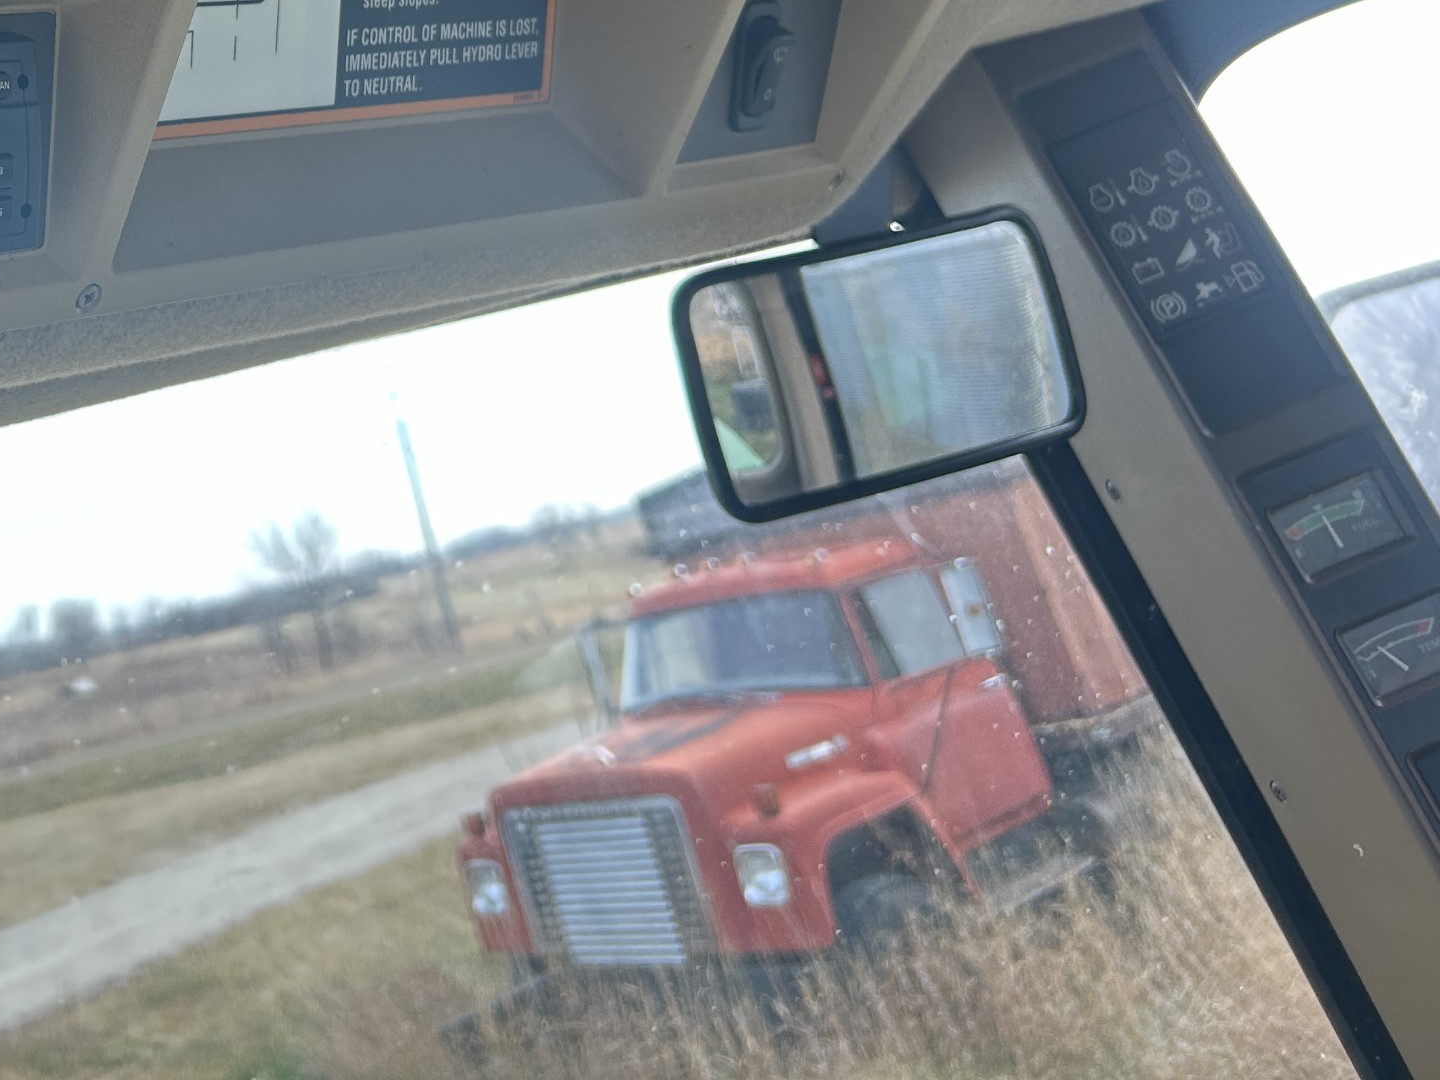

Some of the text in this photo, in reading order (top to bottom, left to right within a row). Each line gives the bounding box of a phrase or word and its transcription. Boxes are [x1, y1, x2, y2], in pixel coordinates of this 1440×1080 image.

[347, 29, 358, 46] IF
[361, 26, 417, 45] CONTROL
[422, 24, 437, 41] OF
[441, 20, 492, 40] MACHINE
[496, 19, 506, 36] IS
[345, 41, 538, 72] IMMEDIATELY PULL HYDRO LEVER
[344, 75, 422, 97] TO NEUTRAL.
